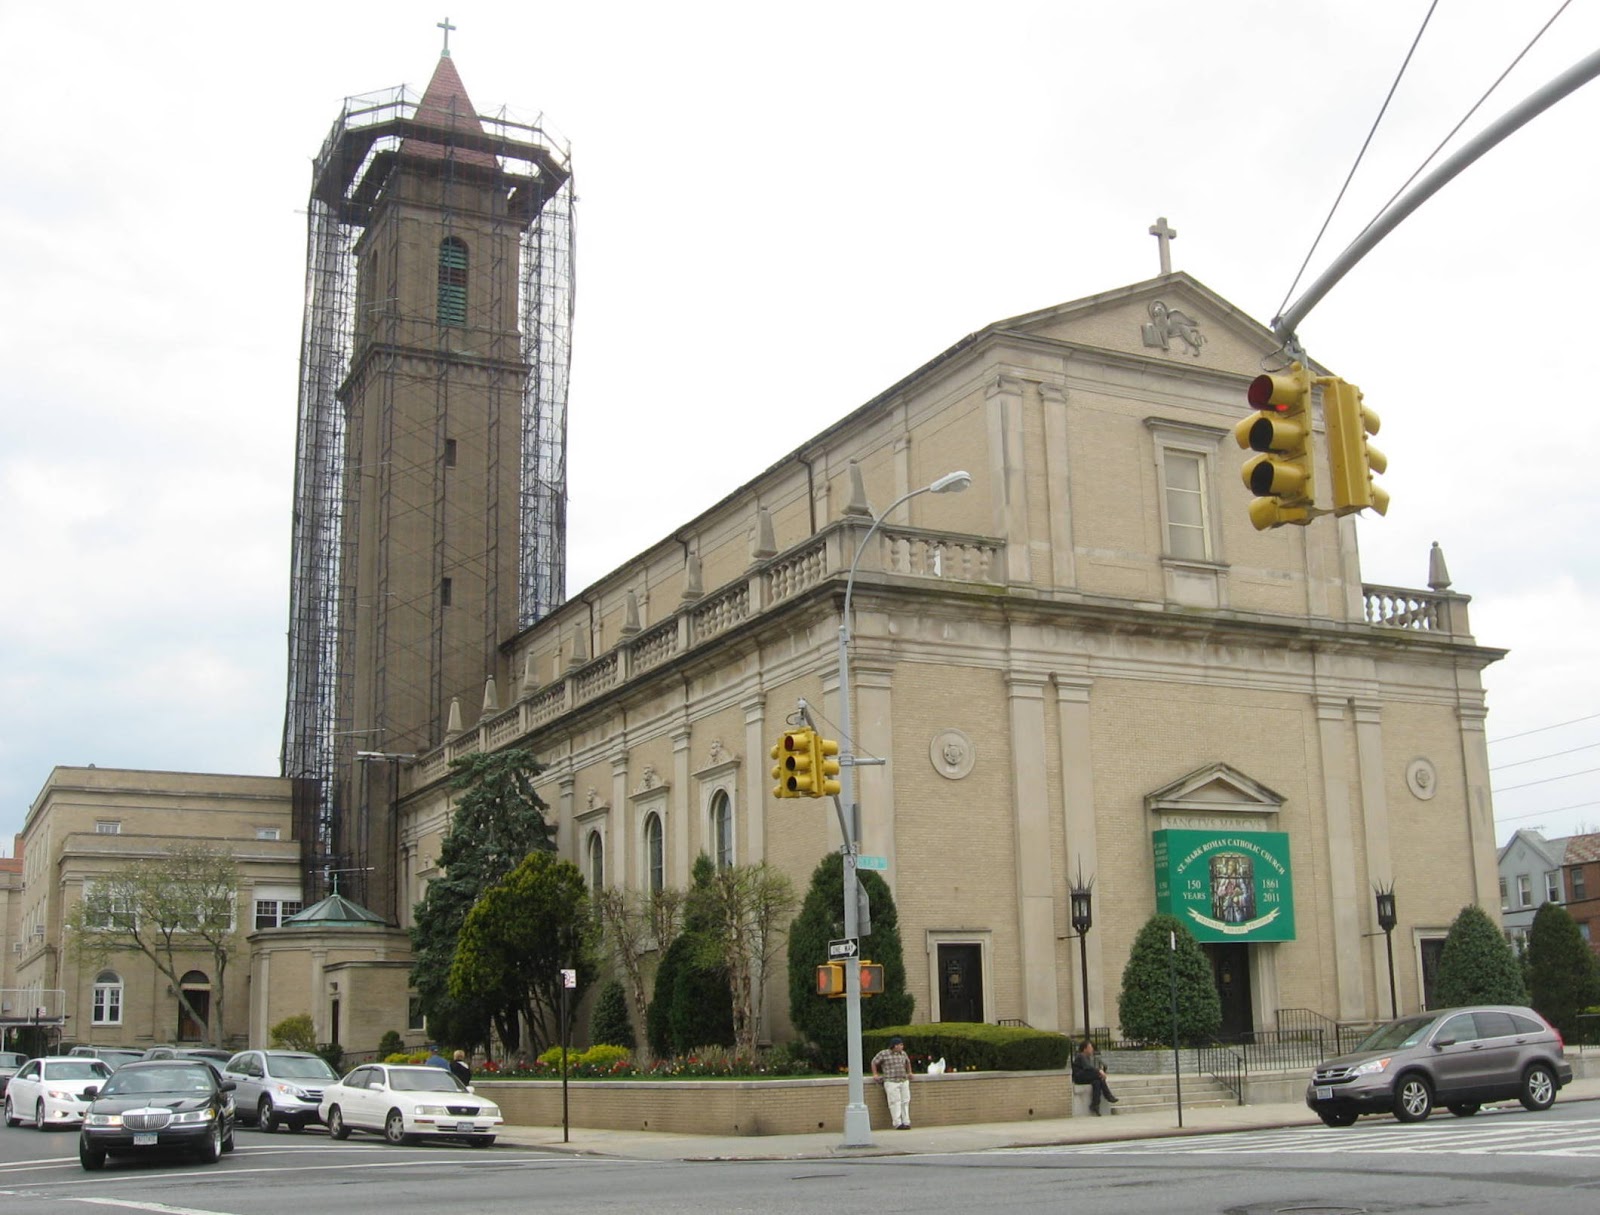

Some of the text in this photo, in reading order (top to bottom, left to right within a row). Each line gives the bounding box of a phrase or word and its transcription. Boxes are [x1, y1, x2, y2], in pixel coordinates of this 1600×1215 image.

[1185, 848, 1204, 864] MARK
[1203, 839, 1227, 852] ROMAN
[1227, 839, 1260, 854] CATHOLIC
[1260, 850, 1285, 875] CHURCH
[1187, 880, 1201, 889] 150
[1262, 879, 1279, 888] 1861
[1183, 892, 1206, 900] YEARS
[1263, 893, 1280, 902] 2011
[845, 944, 854, 952] WAY
